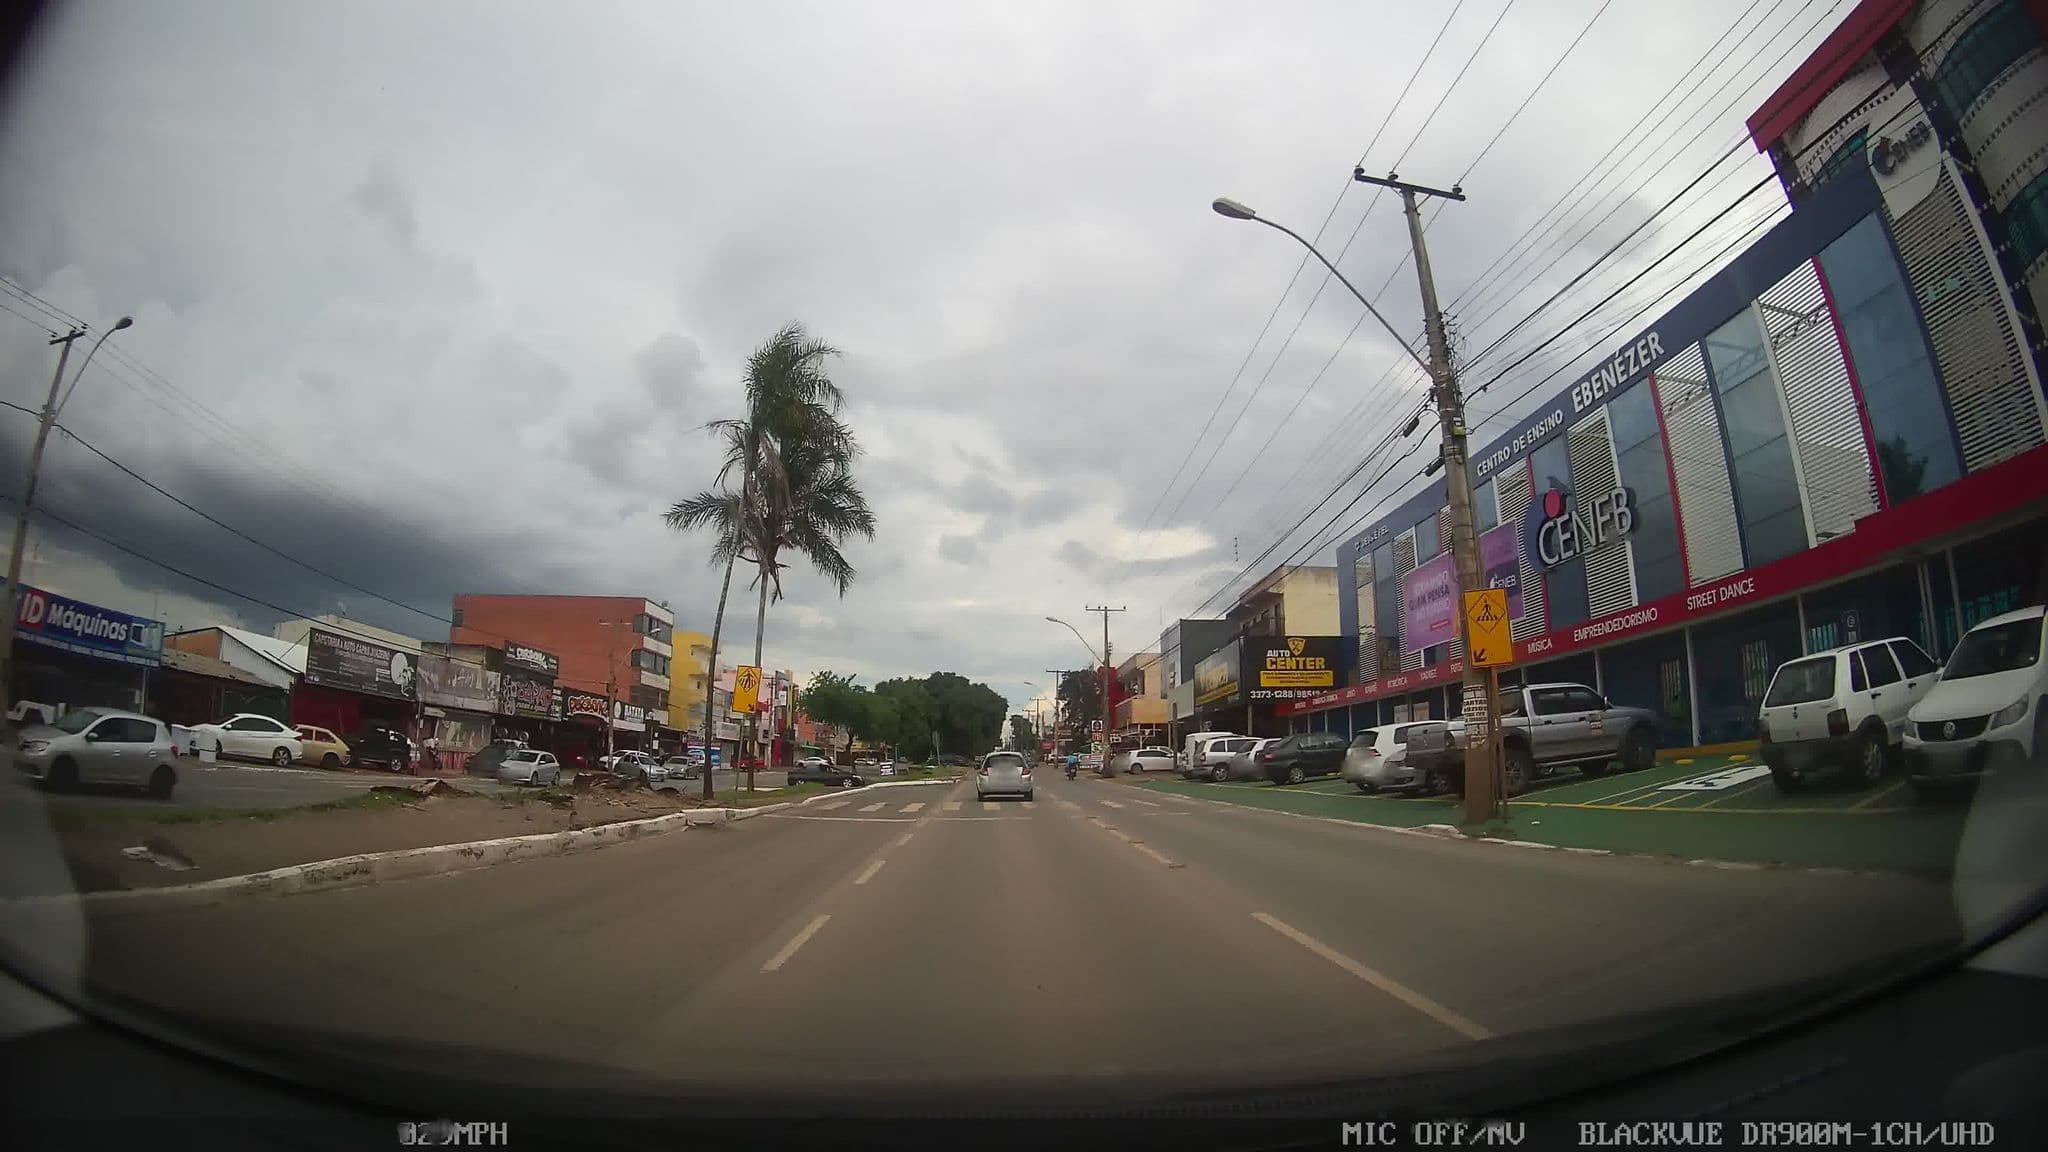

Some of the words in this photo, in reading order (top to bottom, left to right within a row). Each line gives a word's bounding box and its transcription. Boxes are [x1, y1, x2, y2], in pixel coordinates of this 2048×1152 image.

[1477, 447, 1511, 476] CENTRO
[1512, 435, 1527, 454] DE
[1526, 408, 1564, 444] ENSINO
[1571, 331, 1666, 413] EBENÉZER
[1687, 590, 1717, 611] STREET
[1719, 578, 1755, 602] DANCE
[20, 593, 45, 625] ID
[48, 603, 129, 643] Máquinas
[1573, 607, 1658, 642] EMPREENDEDORISMO
[1266, 649, 1290, 657] AUTO
[1528, 638, 1553, 654] MÚSICA
[1265, 657, 1326, 670] CENTER
